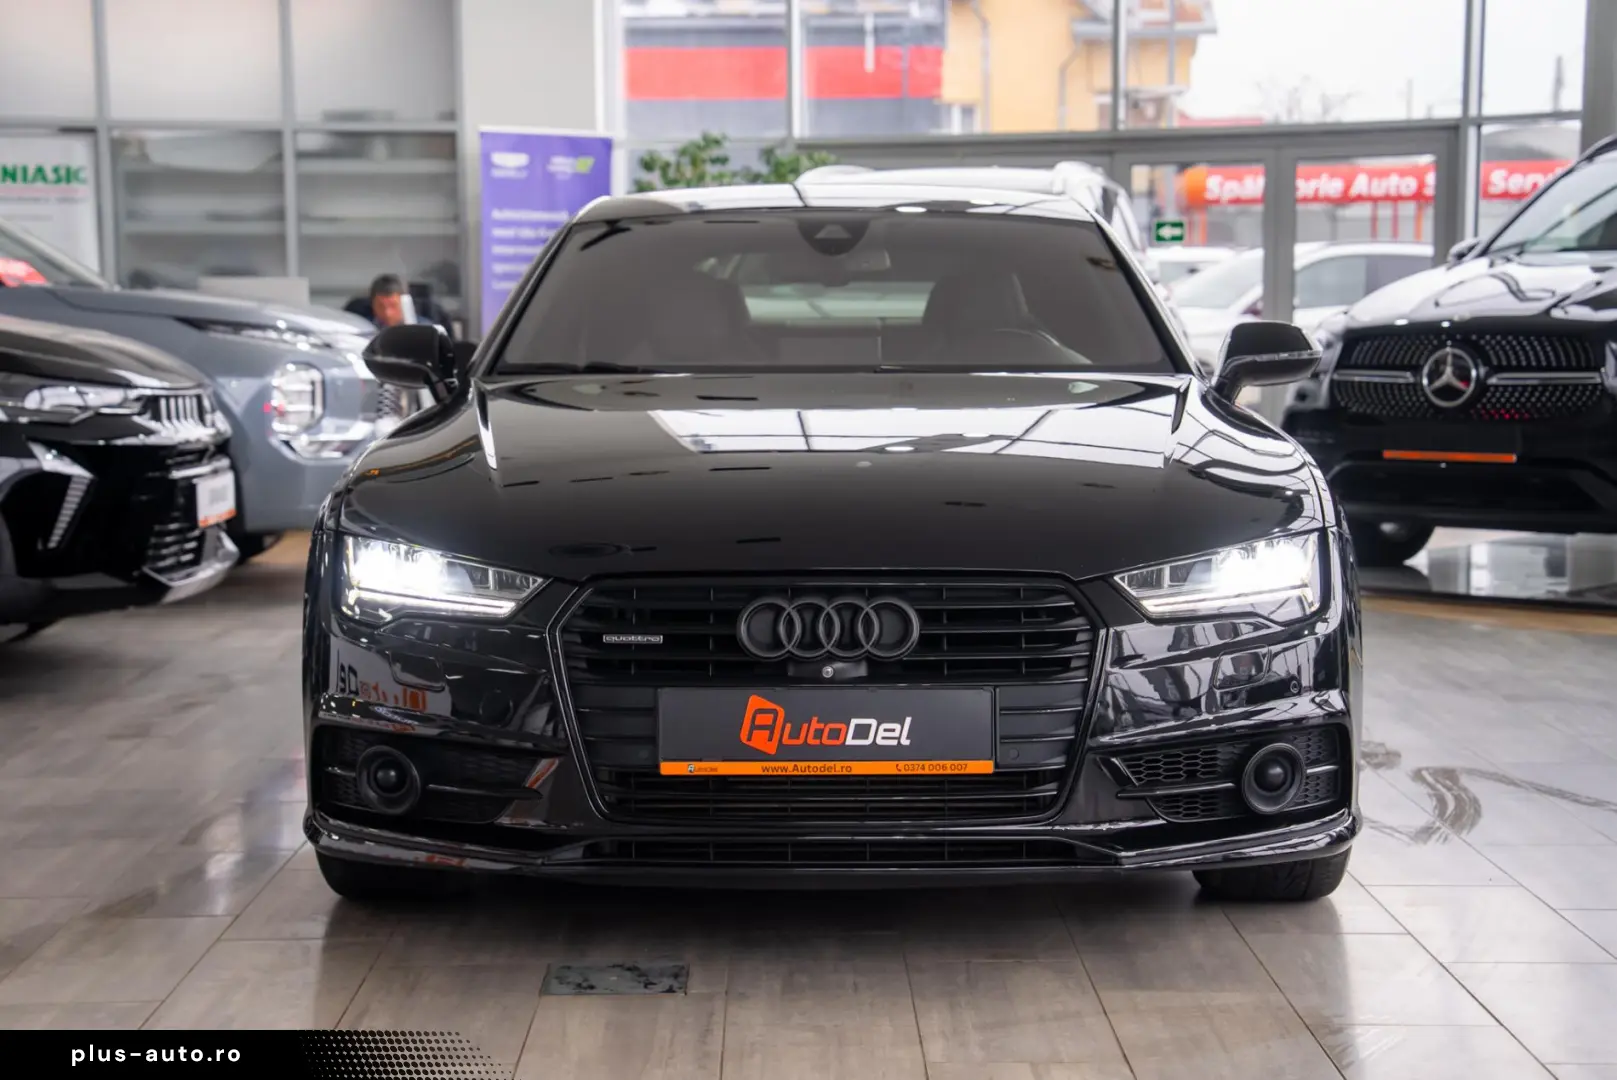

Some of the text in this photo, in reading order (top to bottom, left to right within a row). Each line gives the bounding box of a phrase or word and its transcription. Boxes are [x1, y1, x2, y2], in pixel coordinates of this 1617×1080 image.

[1349, 172, 1417, 200] Auto
[605, 635, 661, 643] quattro
[742, 698, 912, 752] AutoDel
[761, 763, 852, 773] www.Autodel.ro
[903, 763, 926, 772] 0374
